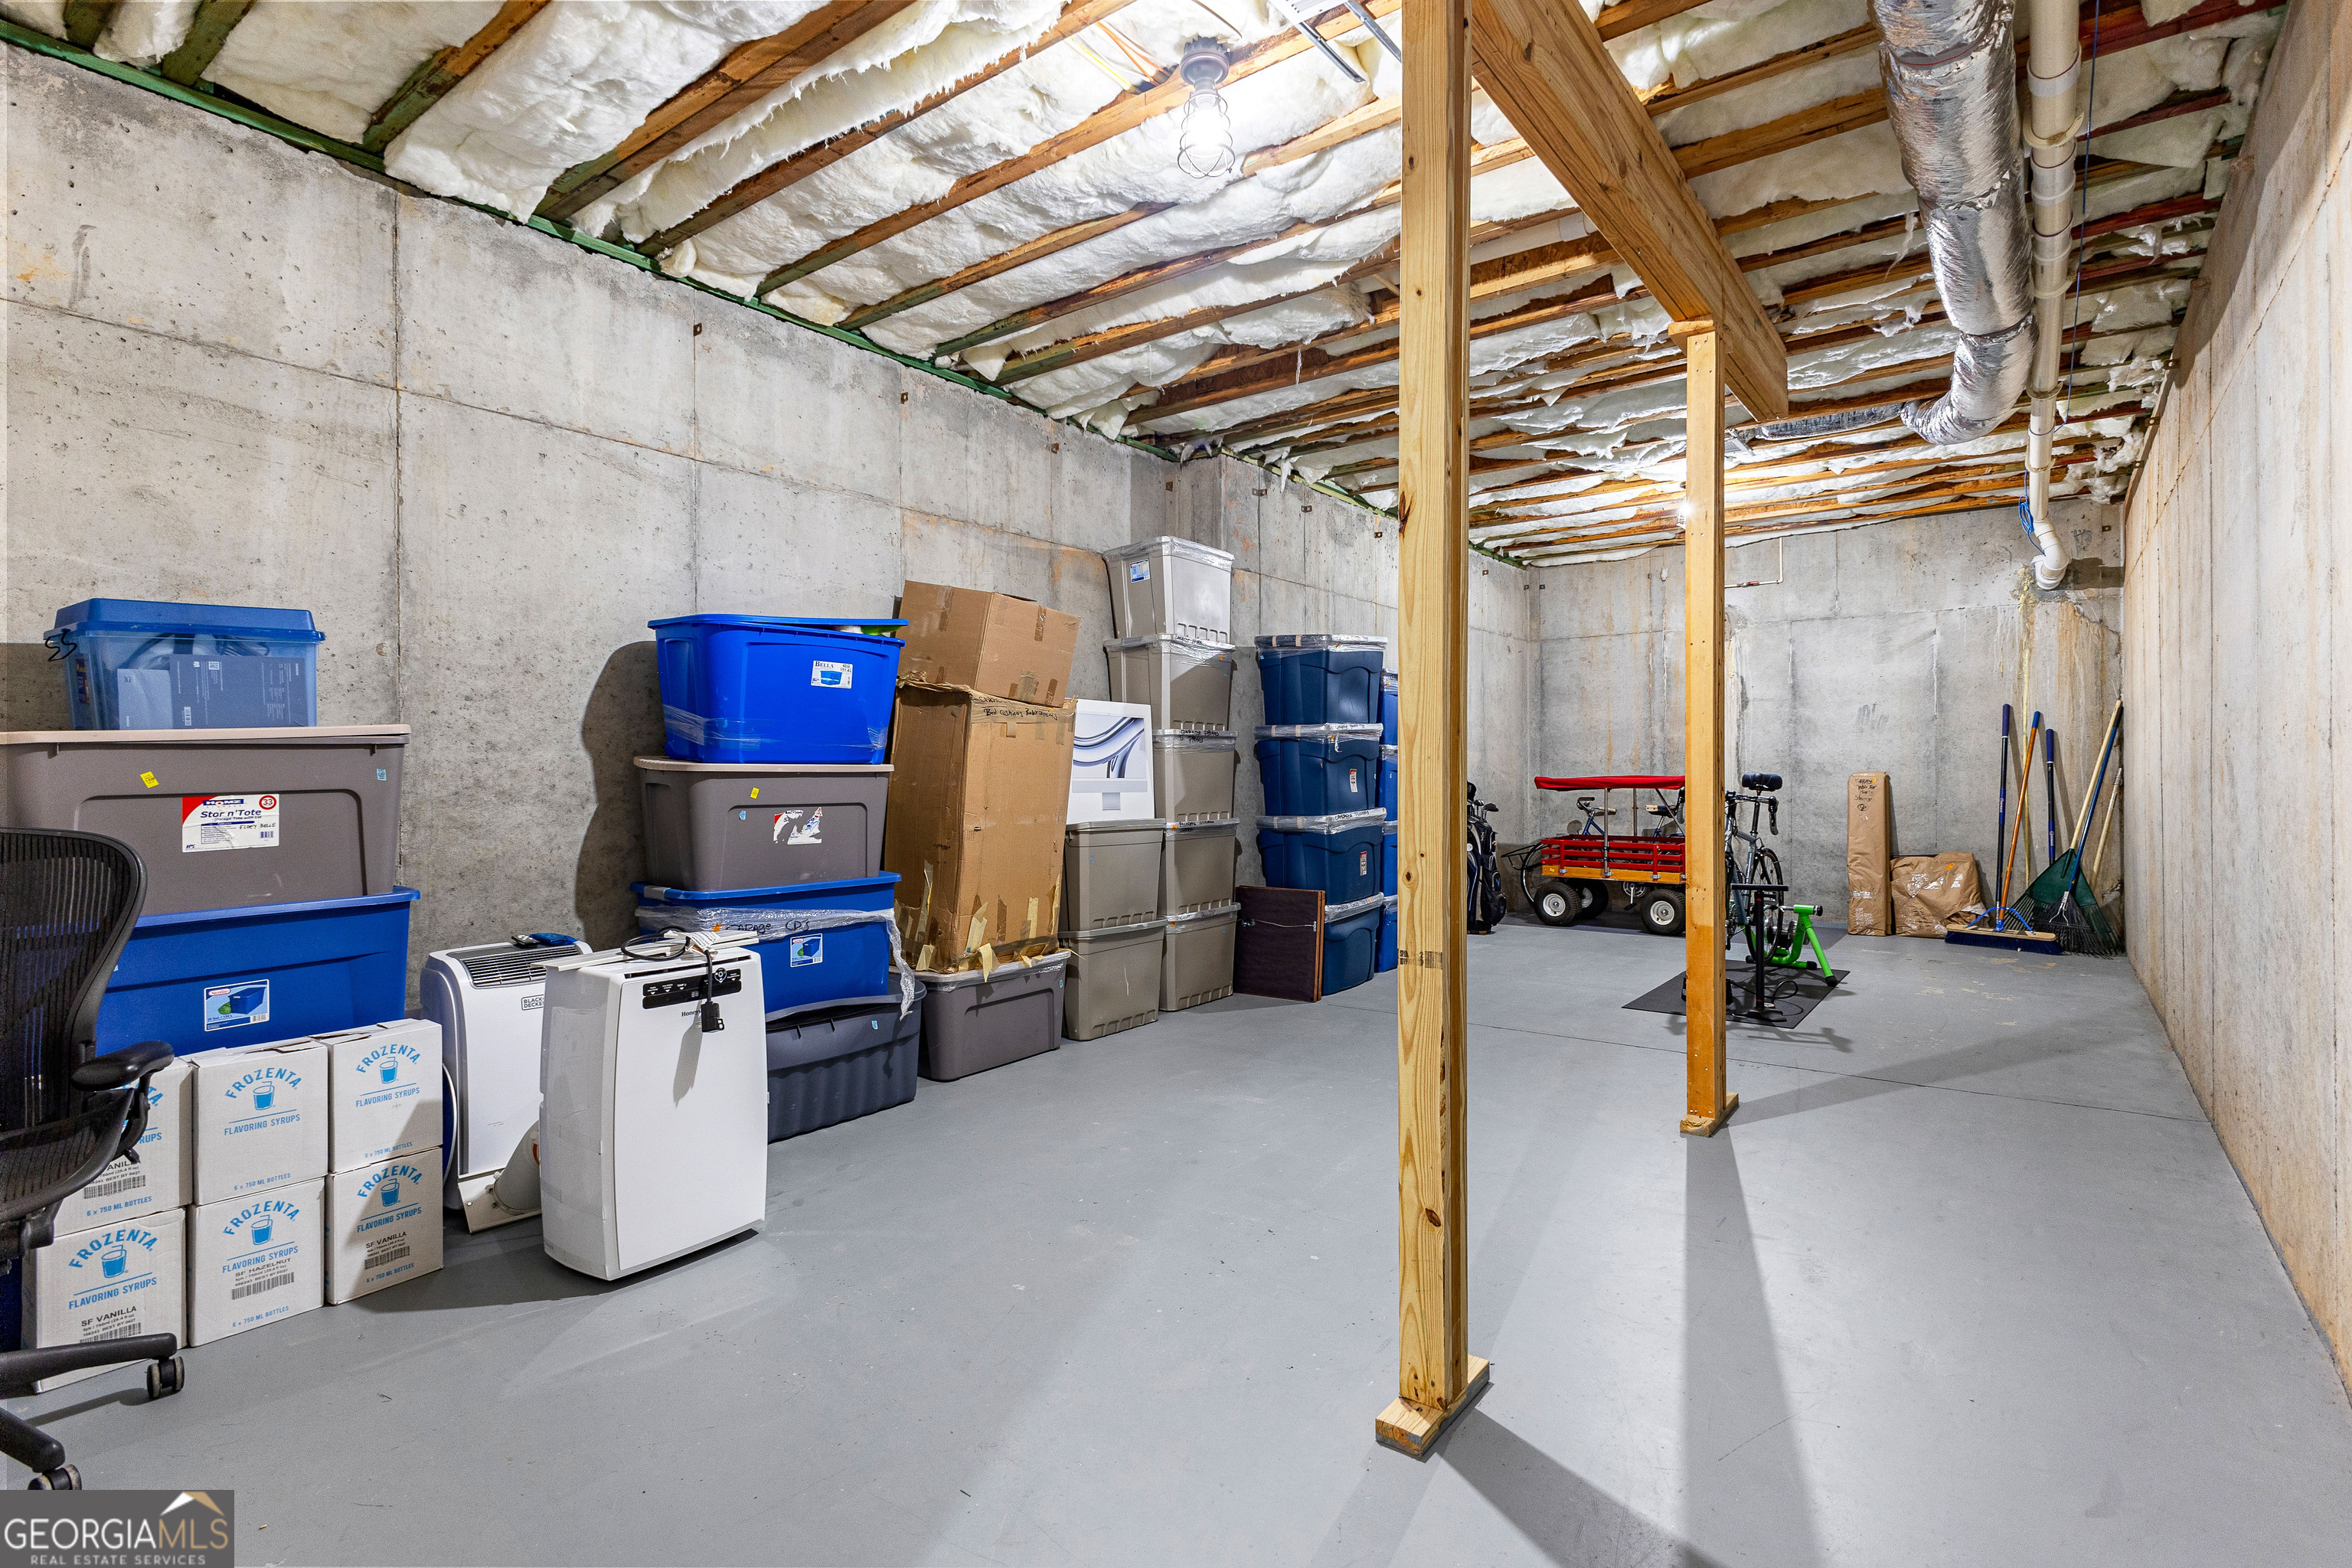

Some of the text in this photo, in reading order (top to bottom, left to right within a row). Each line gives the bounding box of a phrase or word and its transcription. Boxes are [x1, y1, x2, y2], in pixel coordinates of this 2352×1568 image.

[681, 1009, 701, 1018] Honey
[356, 1044, 421, 1073] FROZENTA
[224, 1067, 302, 1099] FROZENTA
[355, 1087, 420, 1107] FLAVORING SYRUPS
[224, 1114, 300, 1135] FLAVORING SYRUPS
[135, 1132, 162, 1145] RUPS
[393, 1142, 413, 1152] BOTTLES
[106, 1160, 131, 1171] ANIL
[267, 1173, 291, 1183] BOTTLES
[357, 1165, 422, 1197] FROZENTA
[124, 1196, 152, 1208] BOTTLES
[223, 1200, 299, 1235] FROZENTA
[357, 1207, 422, 1233] FLAVORING SYRUPS
[377, 1231, 407, 1245] VANILLA
[68, 1229, 158, 1268] FROZENTA
[222, 1246, 299, 1273] FLAVORING SYRUPS
[249, 1258, 291, 1273] HAZELNUT
[394, 1263, 414, 1274] BOTTLES
[68, 1277, 157, 1309] FLAVORING SYRUPS
[81, 1305, 137, 1327] SF VANILLA
[266, 1305, 289, 1318] BOTTLES
